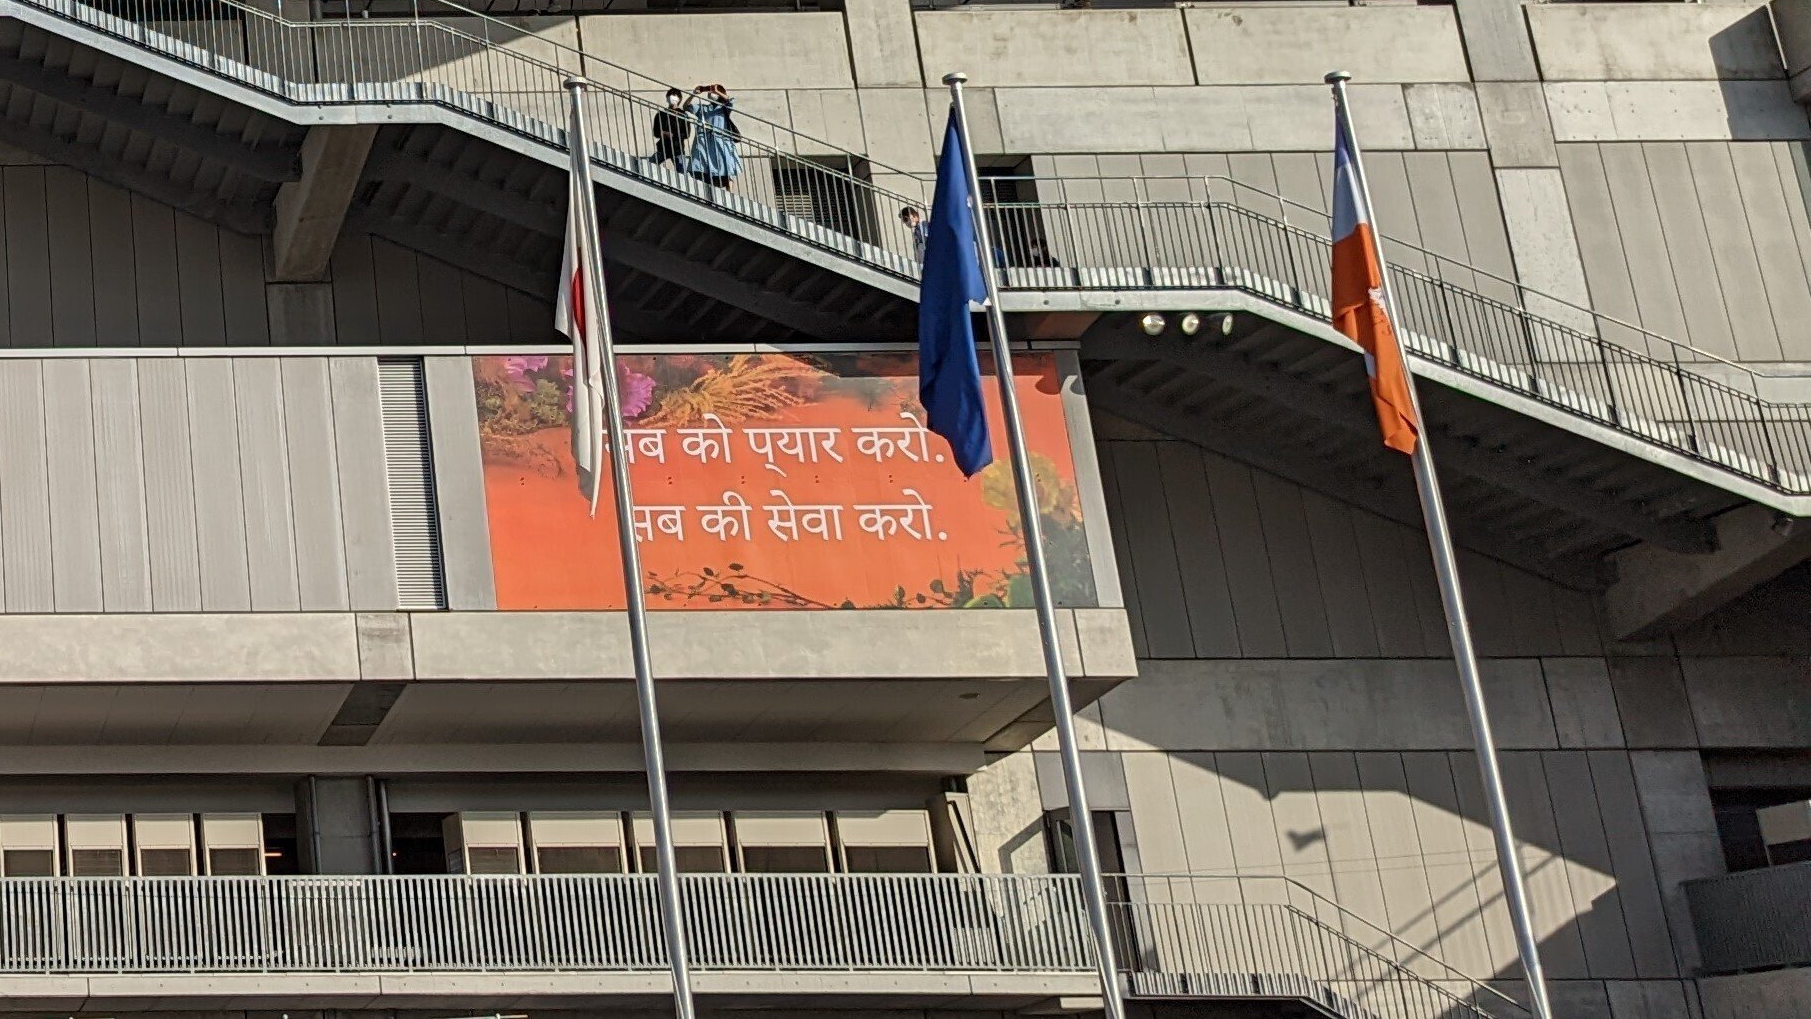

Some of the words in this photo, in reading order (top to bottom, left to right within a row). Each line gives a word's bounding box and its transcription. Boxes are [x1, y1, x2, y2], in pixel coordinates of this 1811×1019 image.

[677, 413, 733, 464] को
[851, 412, 945, 464] करो.
[696, 490, 753, 542] की
[763, 489, 844, 542] सेवा
[853, 488, 948, 542] करो.
